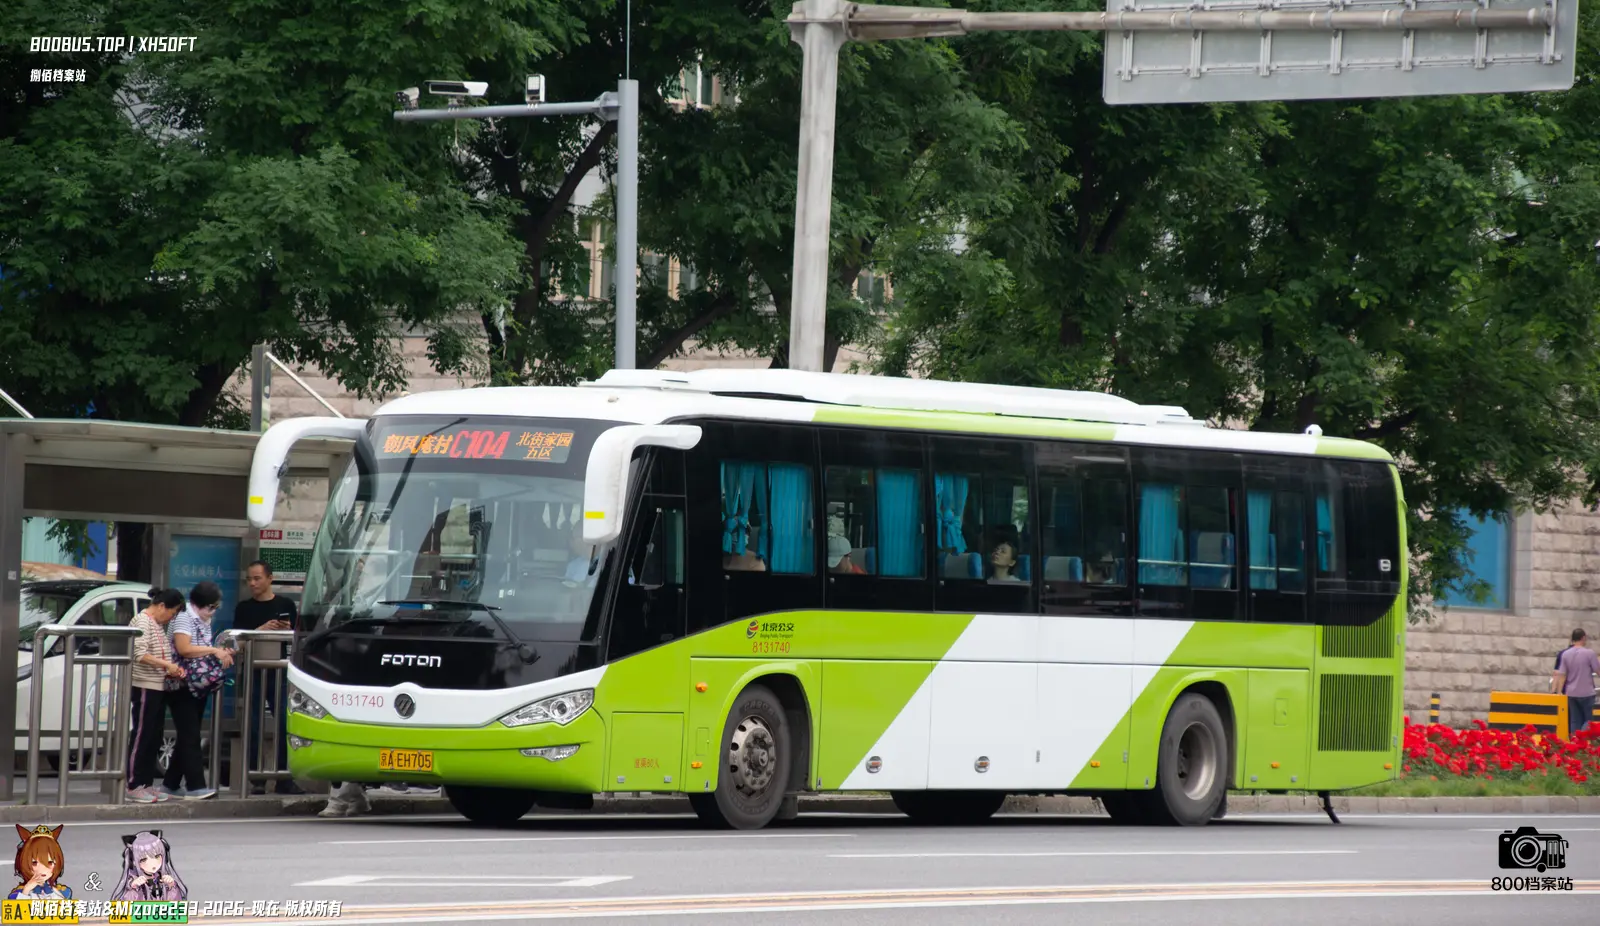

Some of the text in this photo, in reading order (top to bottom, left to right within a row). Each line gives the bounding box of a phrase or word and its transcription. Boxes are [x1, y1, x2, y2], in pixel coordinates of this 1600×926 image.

[450, 430, 511, 459] C104
[515, 431, 575, 448] 北街家园
[522, 446, 555, 460] 五区
[761, 622, 795, 632] 北京公交
[752, 641, 791, 654] 8131740
[380, 654, 442, 668] FOTON
[331, 693, 384, 708] 8131740
